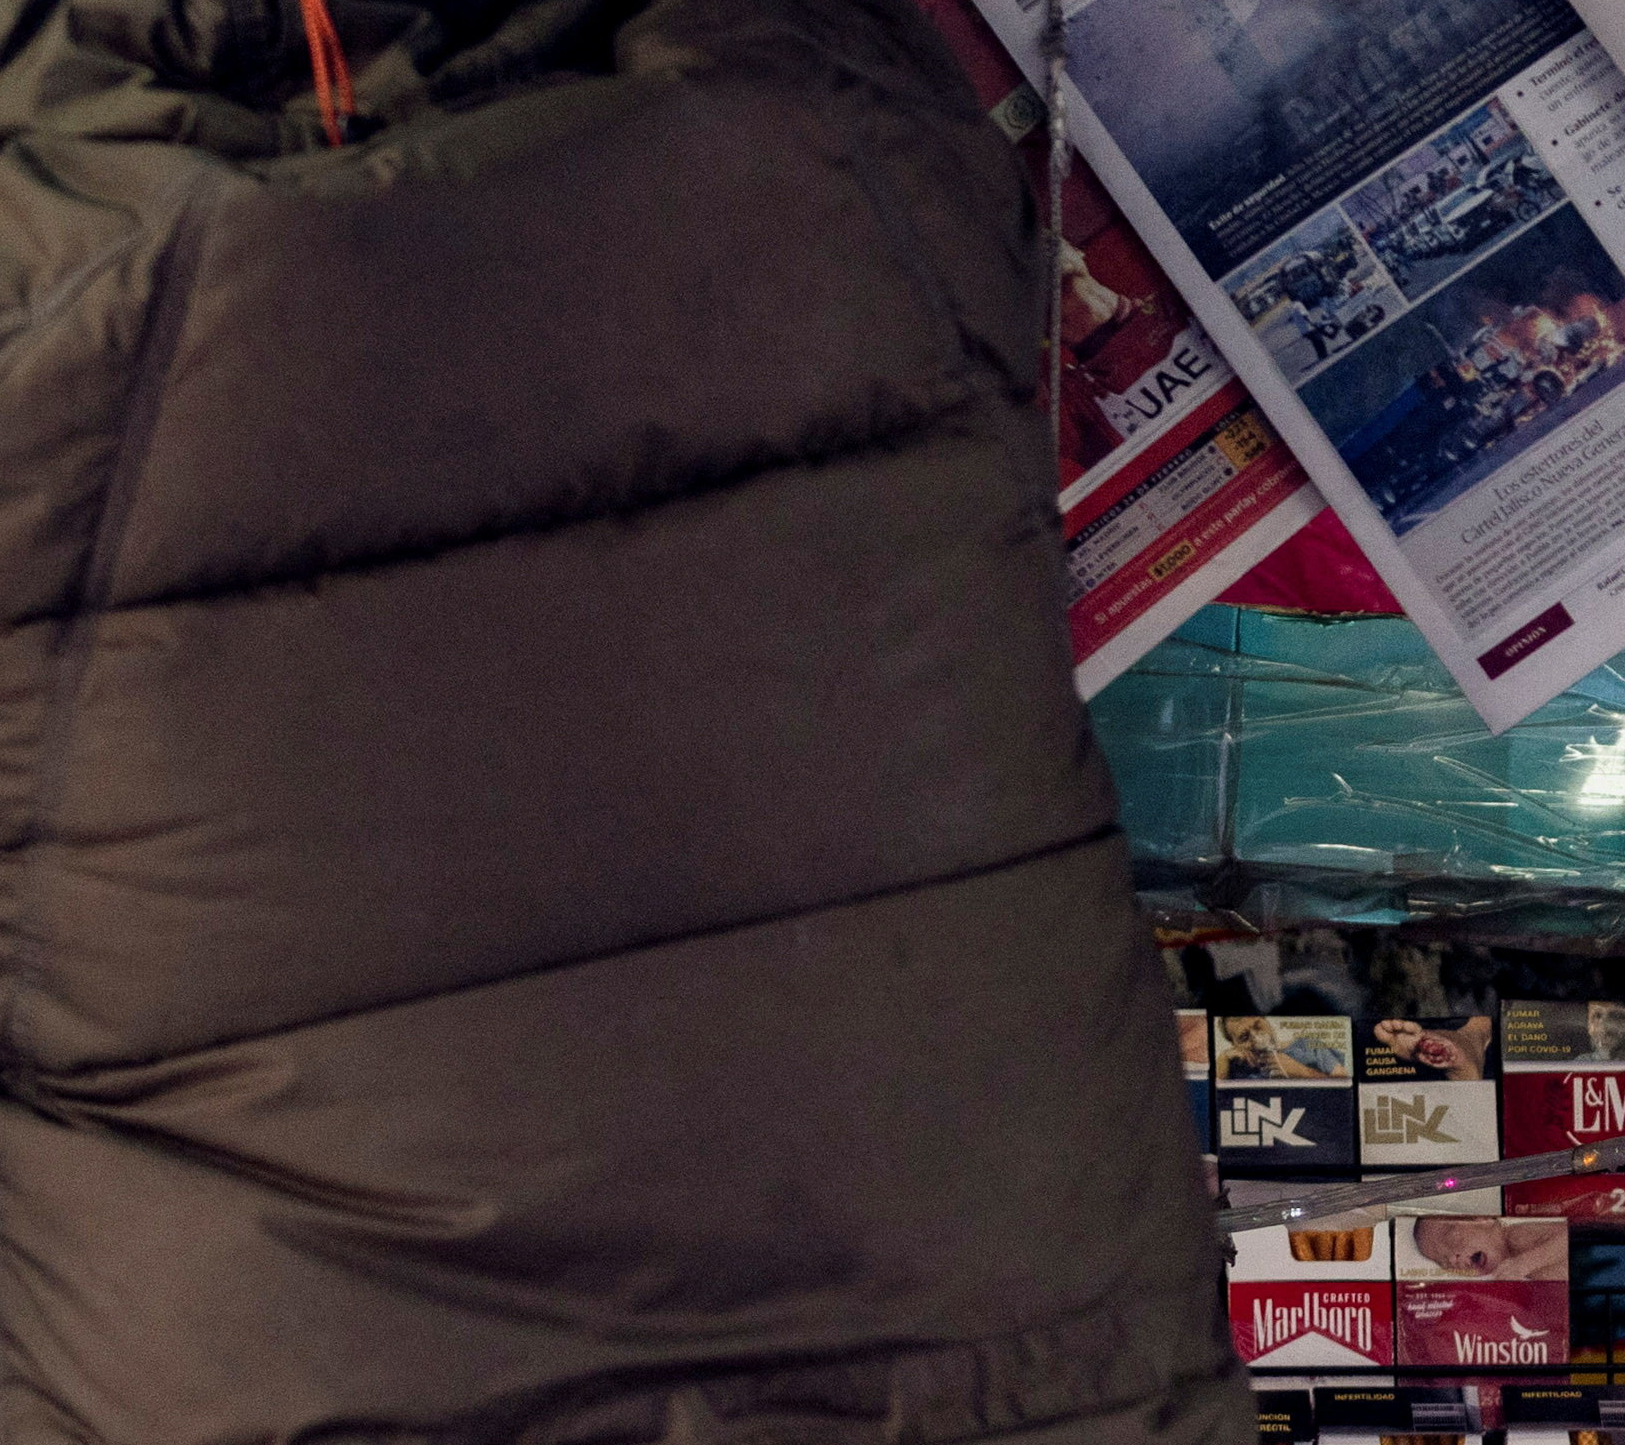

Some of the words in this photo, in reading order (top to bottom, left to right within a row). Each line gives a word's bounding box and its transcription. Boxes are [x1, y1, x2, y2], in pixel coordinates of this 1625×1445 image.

[1129, 344, 1211, 421] UAE
[1540, 458, 1584, 489] Nueva
[1323, 1293, 1370, 1303] CRAFTED
[1254, 1293, 1372, 1353] Marlboro
[1454, 1330, 1548, 1365] Winston
